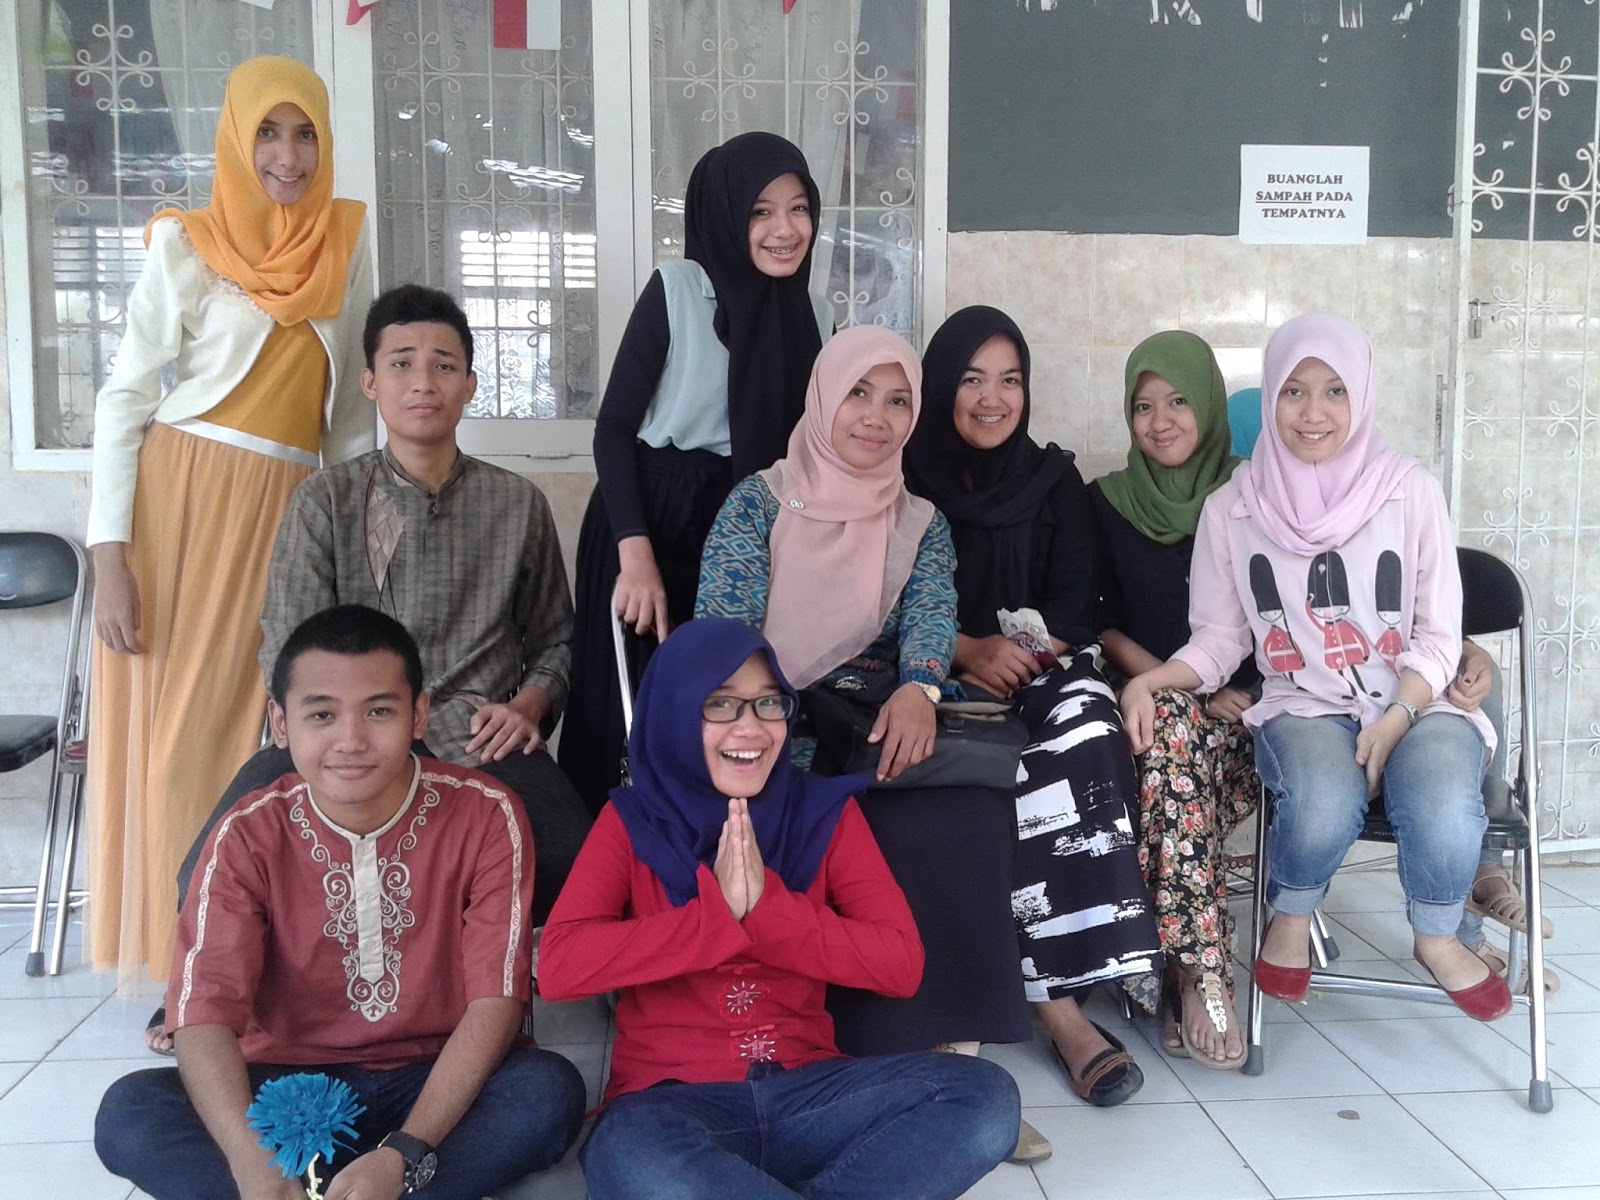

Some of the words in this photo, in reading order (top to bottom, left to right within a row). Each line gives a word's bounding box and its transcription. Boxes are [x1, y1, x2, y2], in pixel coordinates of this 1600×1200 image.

[1267, 174, 1343, 184] BUANGLAH
[1255, 191, 1312, 202] SAMPAH
[1315, 191, 1353, 201] PADA
[1262, 208, 1346, 218] TEMPATNYA
